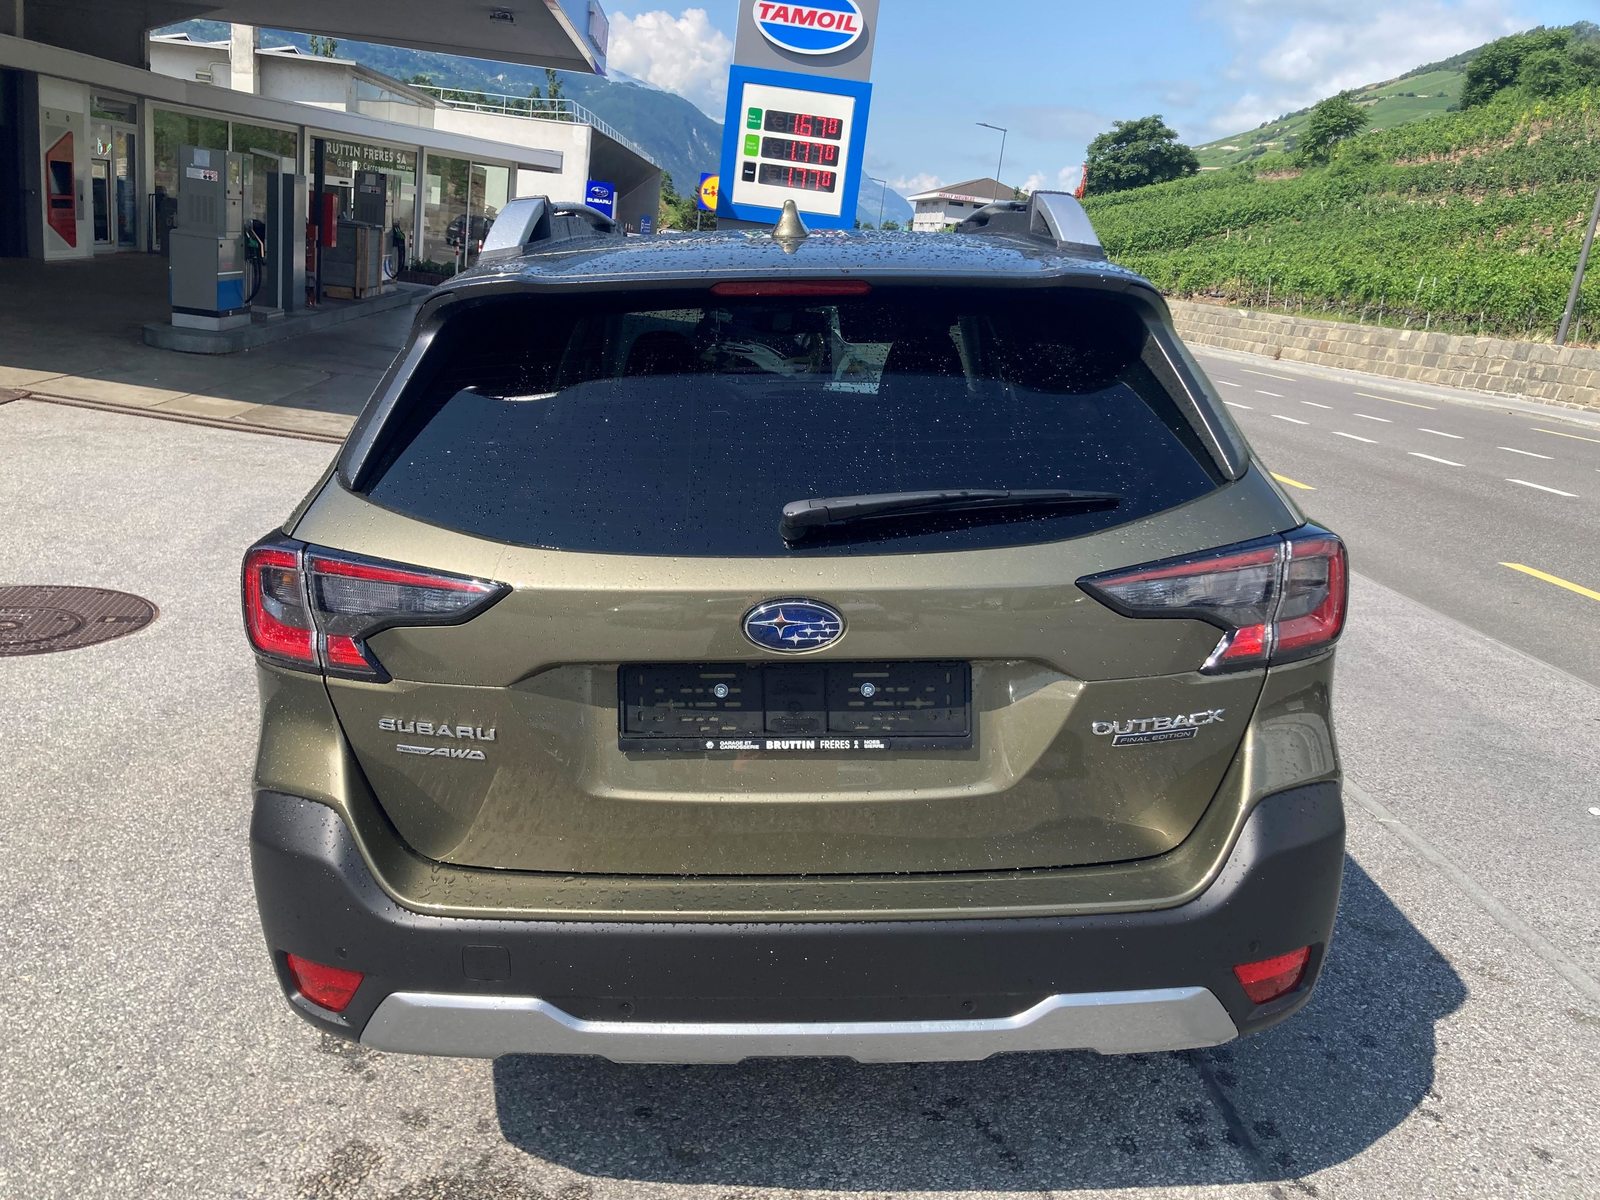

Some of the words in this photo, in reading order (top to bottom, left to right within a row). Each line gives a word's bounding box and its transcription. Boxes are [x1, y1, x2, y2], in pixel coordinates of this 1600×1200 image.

[759, 3, 857, 32] TAMOIL
[326, 142, 360, 157] RUTTIN
[396, 152, 407, 164] SA
[587, 197, 612, 205] SUBARU
[378, 718, 496, 741] SUBARU
[1092, 708, 1225, 735] OUTBACK
[766, 740, 815, 749] BRUTTIN
[1120, 735, 1150, 744] FINAL
[1151, 731, 1192, 741] EDITION
[429, 747, 486, 760] AWD
